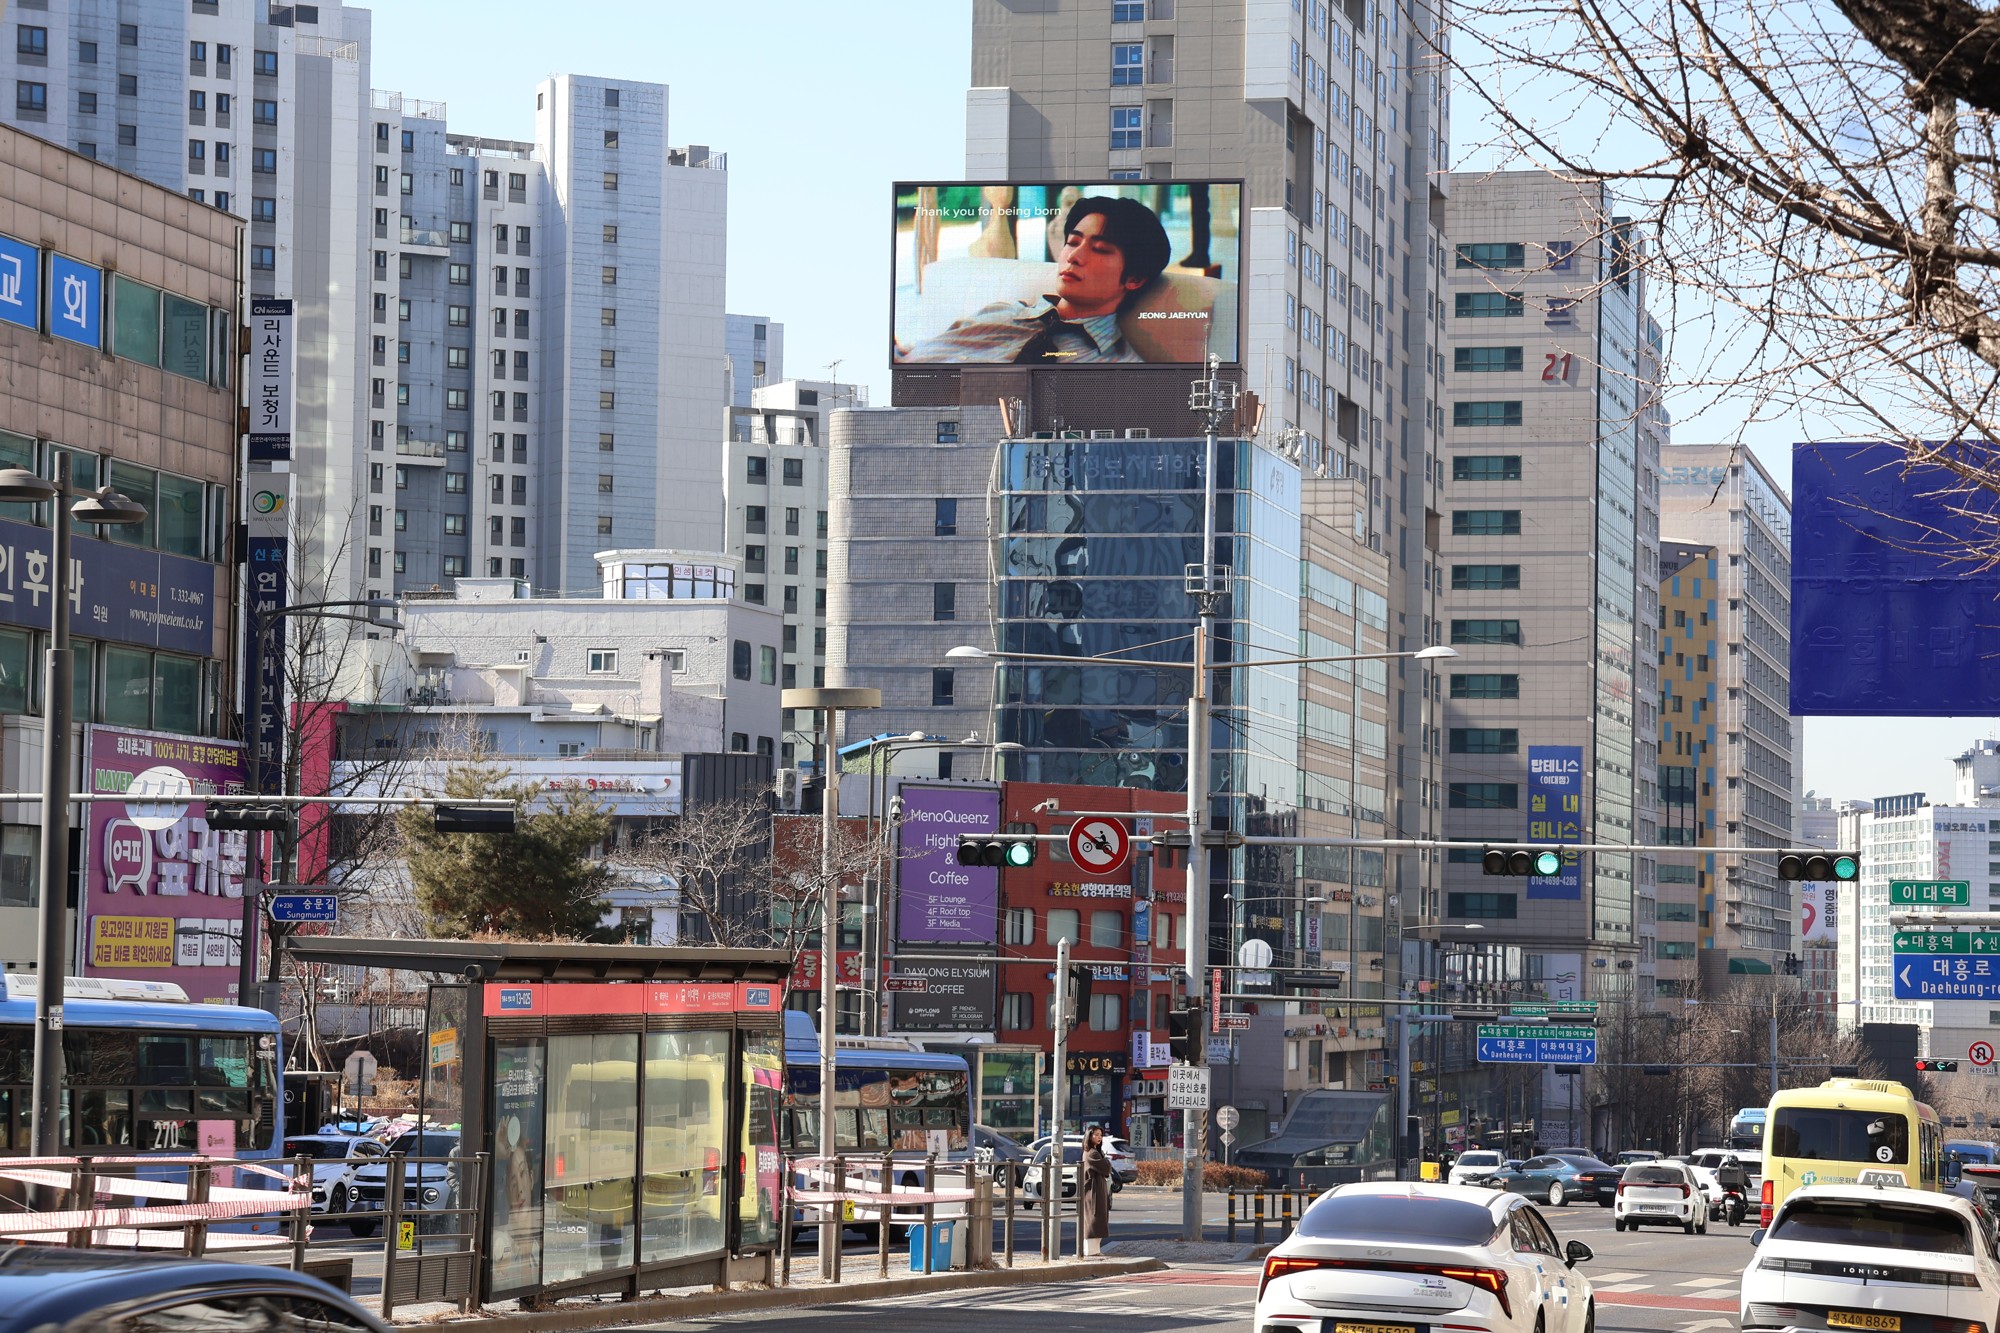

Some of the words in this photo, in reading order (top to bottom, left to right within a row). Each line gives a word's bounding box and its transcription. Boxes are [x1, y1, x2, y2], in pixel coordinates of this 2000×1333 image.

[913, 206, 951, 217] Thank
[953, 208, 975, 218] you
[978, 206, 995, 217] for
[998, 206, 1031, 218] being
[1034, 206, 1061, 217] born
[1137, 311, 1167, 320] JEONG
[1168, 311, 1208, 320] JAEHYUN
[262, 319, 282, 378] 리사운드
[262, 384, 280, 429] 보청기
[255, 548, 282, 561] 신촌
[178, 588, 204, 606] 332-0967
[93, 604, 108, 623] 의원
[116, 736, 152, 757] 휴대폰구매
[154, 741, 175, 759] 100%
[207, 747, 238, 767] 안당하는법
[1531, 758, 1579, 773] 탑테니스
[1539, 775, 1570, 785] (이대점)
[910, 808, 990, 825] MenoQueenz
[1530, 821, 1579, 840] 테니스
[944, 853, 954, 865] &
[928, 871, 969, 886] Coffee
[1902, 884, 1957, 902] 이대역
[302, 898, 335, 910] 숭문길
[928, 895, 938, 904] 5F
[940, 895, 967, 905] Lounge
[286, 910, 335, 920] Sungmun-gil
[927, 907, 938, 917] 4F
[940, 907, 957, 917] Roof
[957, 908, 971, 918] top
[927, 918, 938, 928] 3F
[939, 918, 961, 928] Media
[100, 920, 133, 939] 잊고있던
[134, 921, 142, 939] 내
[145, 921, 169, 940] 지원금
[1911, 935, 1953, 951] 대흥역
[95, 944, 112, 963] 지금
[114, 945, 131, 963] 바로
[133, 945, 172, 964] 확인하세요
[181, 943, 198, 957] 지원금
[206, 943, 225, 957] 48만원
[904, 967, 949, 977] DAYLONG
[951, 968, 990, 978] ELYSIUM
[1933, 959, 1992, 982] 대흥로
[928, 984, 965, 995] COFFEE
[1488, 1027, 1509, 1037] 대흥역
[1526, 1028, 1555, 1037] 신촌로터리
[1557, 1029, 1587, 1038] 이화여대
[1496, 1039, 1526, 1051] 대흥로
[1541, 1041, 1583, 1054] 이화여대길
[1490, 1051, 1533, 1060] Daeheung-ro
[1172, 1069, 1200, 1081] 이곳에서
[1171, 1082, 1207, 1095] 다음신호를
[1171, 1095, 1207, 1107] 기다리시오
[153, 1121, 179, 1149] 270
[1881, 1148, 1889, 1160] 5
[1868, 1173, 1900, 1184] TAXI
[1865, 1315, 1896, 1329] 8869
